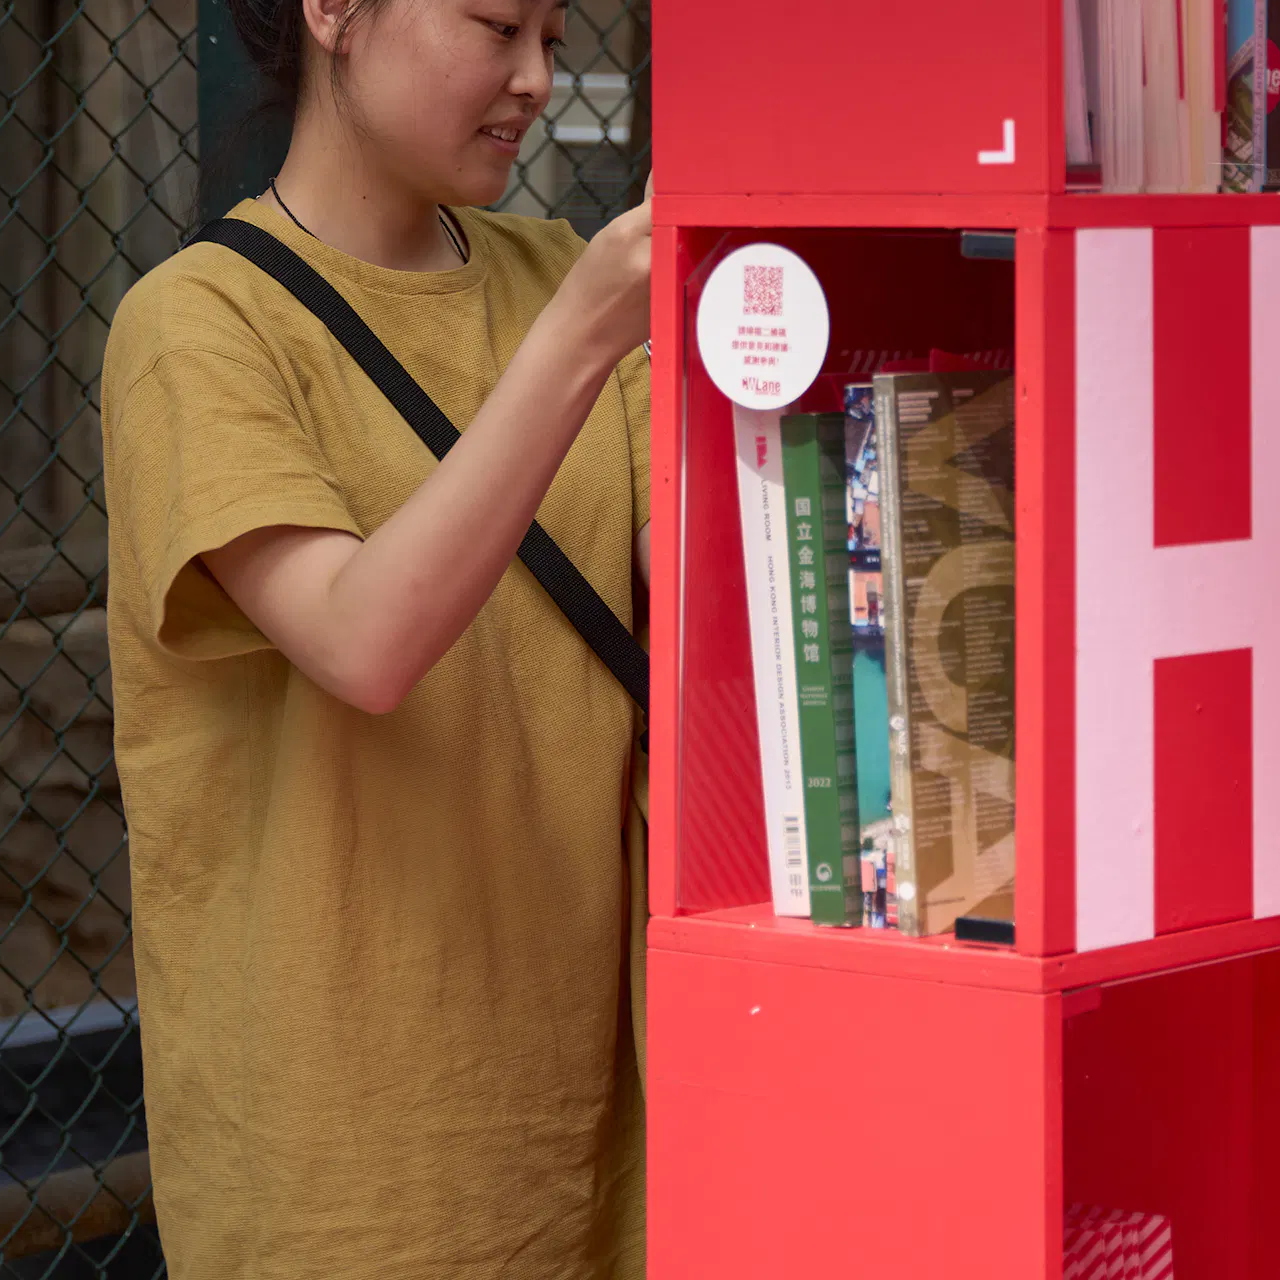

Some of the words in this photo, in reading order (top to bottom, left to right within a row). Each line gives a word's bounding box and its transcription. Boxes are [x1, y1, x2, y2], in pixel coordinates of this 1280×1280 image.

[761, 479, 770, 511] LIVING
[764, 513, 772, 542] ROOM
[767, 555, 776, 583] HONG
[794, 497, 820, 663] 国立金海博物馆
[770, 586, 778, 614] KONG
[772, 616, 782, 662] INTERIOR
[775, 663, 785, 700] DESIGN
[779, 702, 789, 768] ASSOCIATION
[807, 776, 833, 789] 2022
